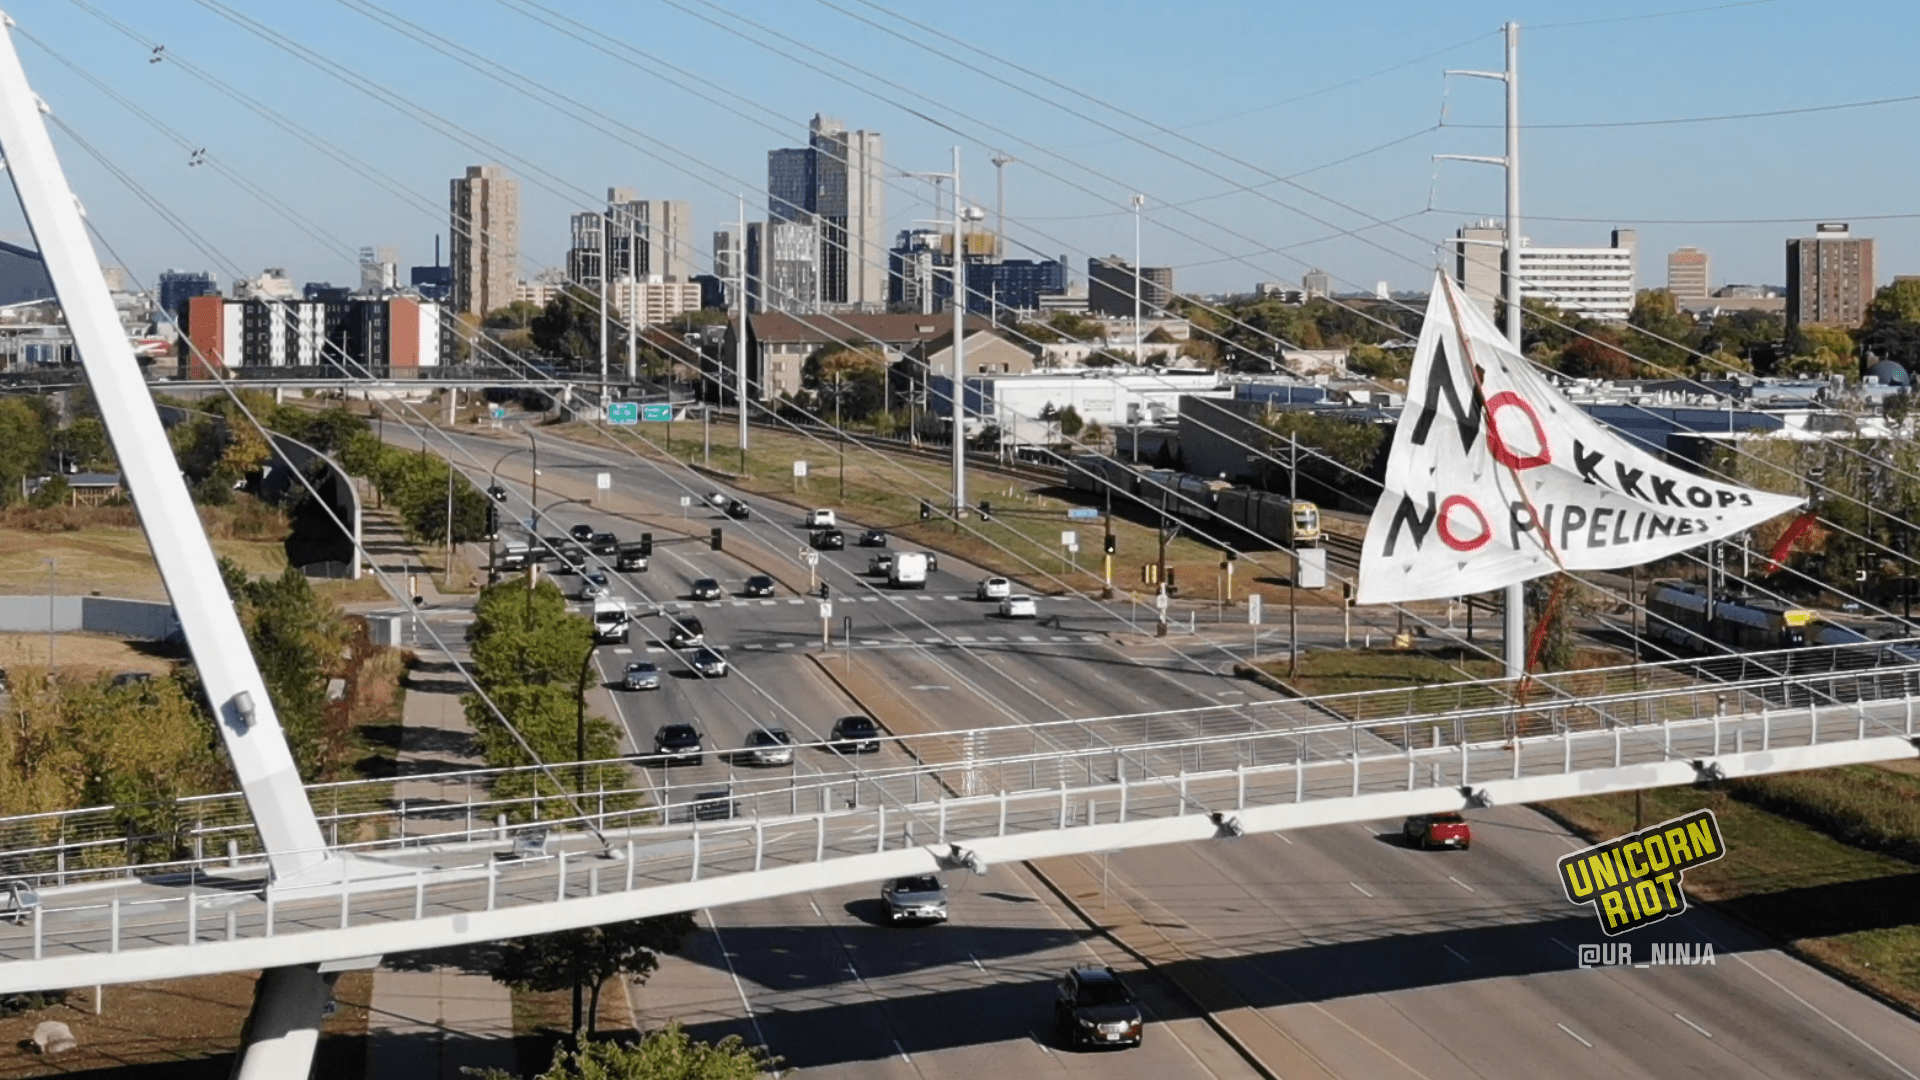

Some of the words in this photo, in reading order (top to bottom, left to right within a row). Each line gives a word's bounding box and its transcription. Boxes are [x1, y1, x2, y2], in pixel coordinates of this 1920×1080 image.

[1411, 334, 1551, 470] NO
[1573, 438, 1753, 508] KKKOPS
[1382, 490, 1492, 557] NO
[1510, 500, 1709, 551] PIPELINES
